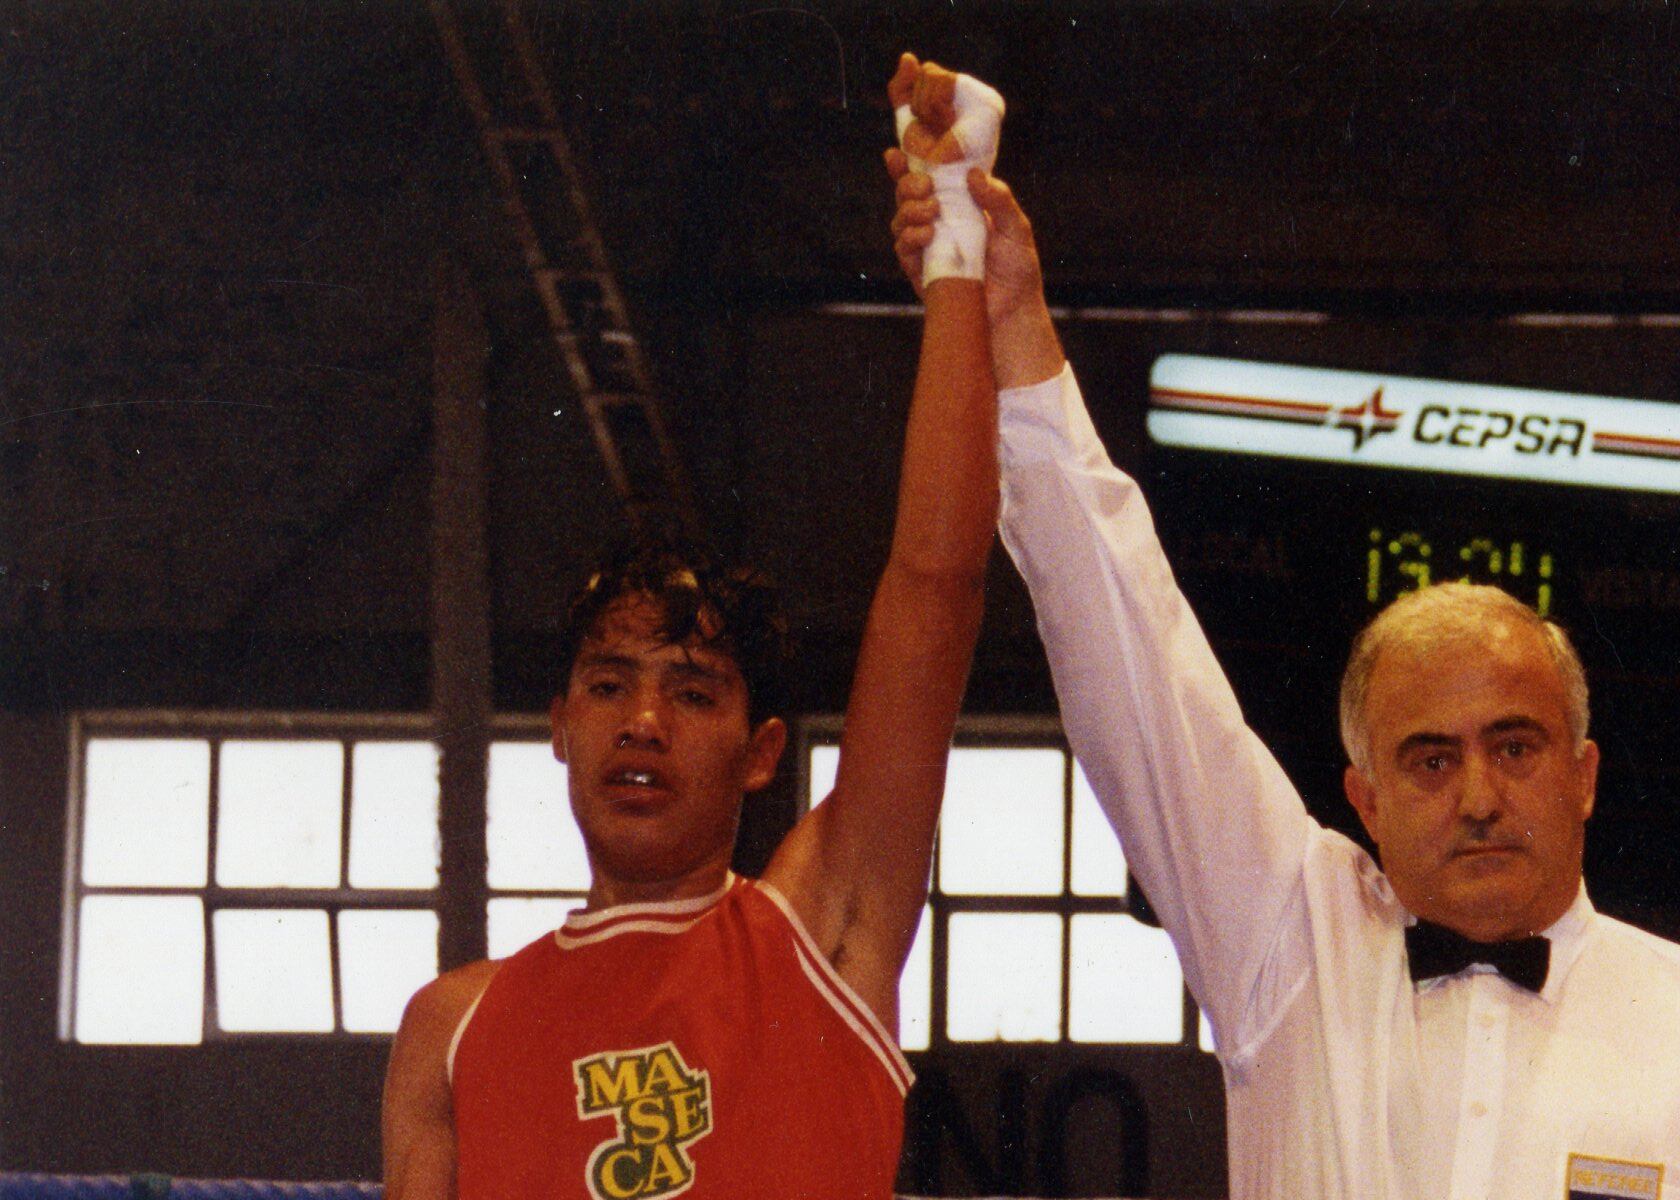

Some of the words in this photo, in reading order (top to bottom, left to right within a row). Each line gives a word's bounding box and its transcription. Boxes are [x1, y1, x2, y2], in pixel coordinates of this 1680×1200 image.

[1413, 404, 1586, 457] CEPSA
[583, 1048, 694, 1110] MA
[626, 1087, 711, 1146] SE
